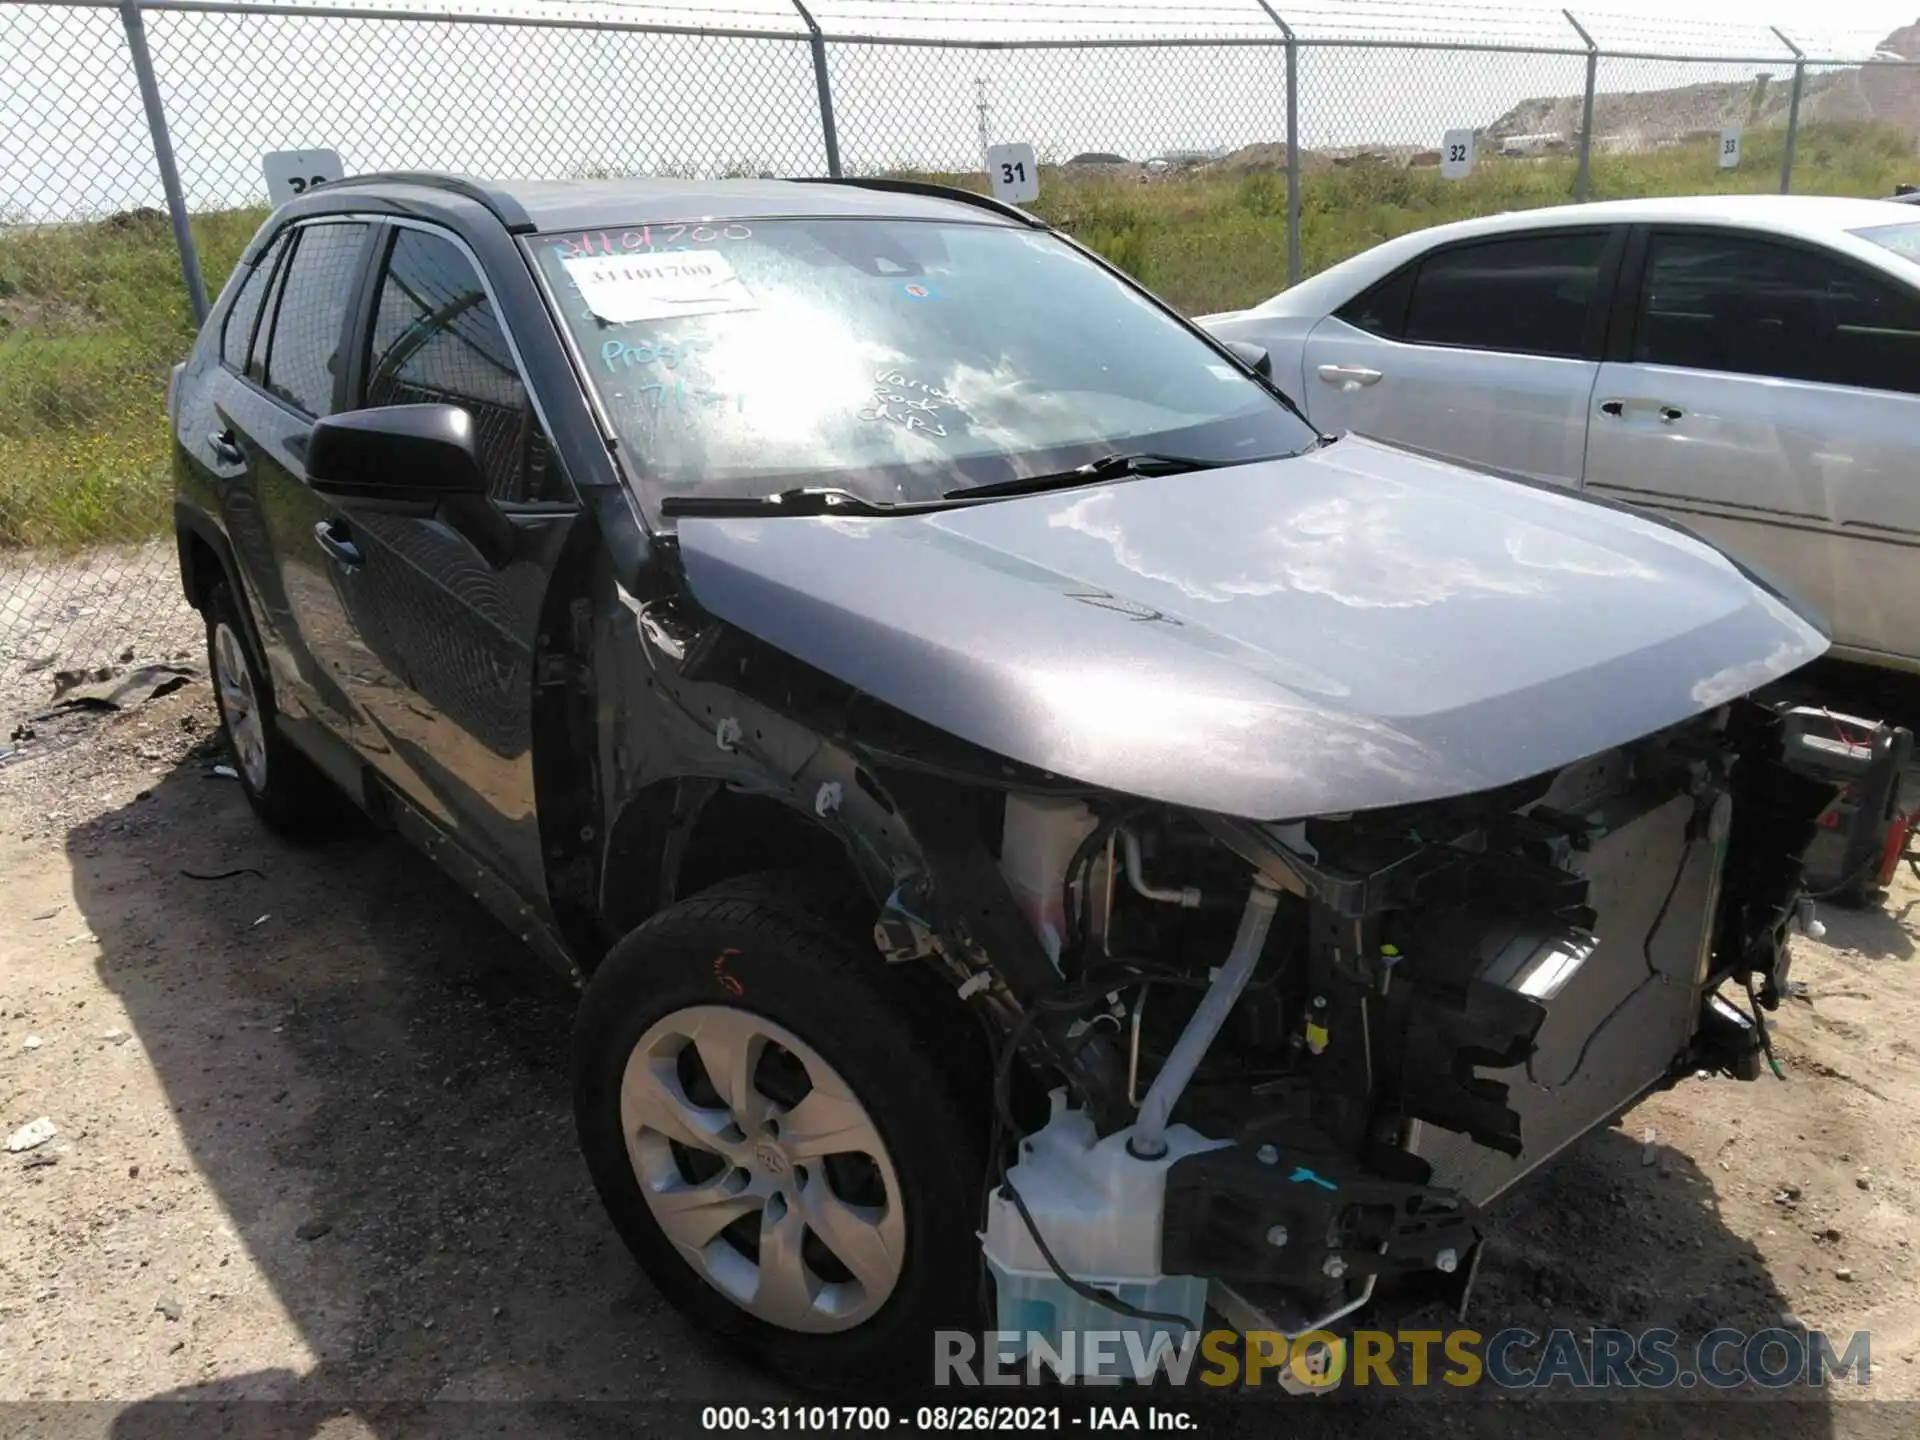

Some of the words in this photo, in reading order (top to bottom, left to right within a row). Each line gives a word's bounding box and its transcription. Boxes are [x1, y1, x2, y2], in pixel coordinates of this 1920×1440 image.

[1450, 144, 1466, 162] 32
[1723, 139, 1736, 154] 33
[1001, 162, 1025, 184] 31
[590, 264, 714, 285] 31101700
